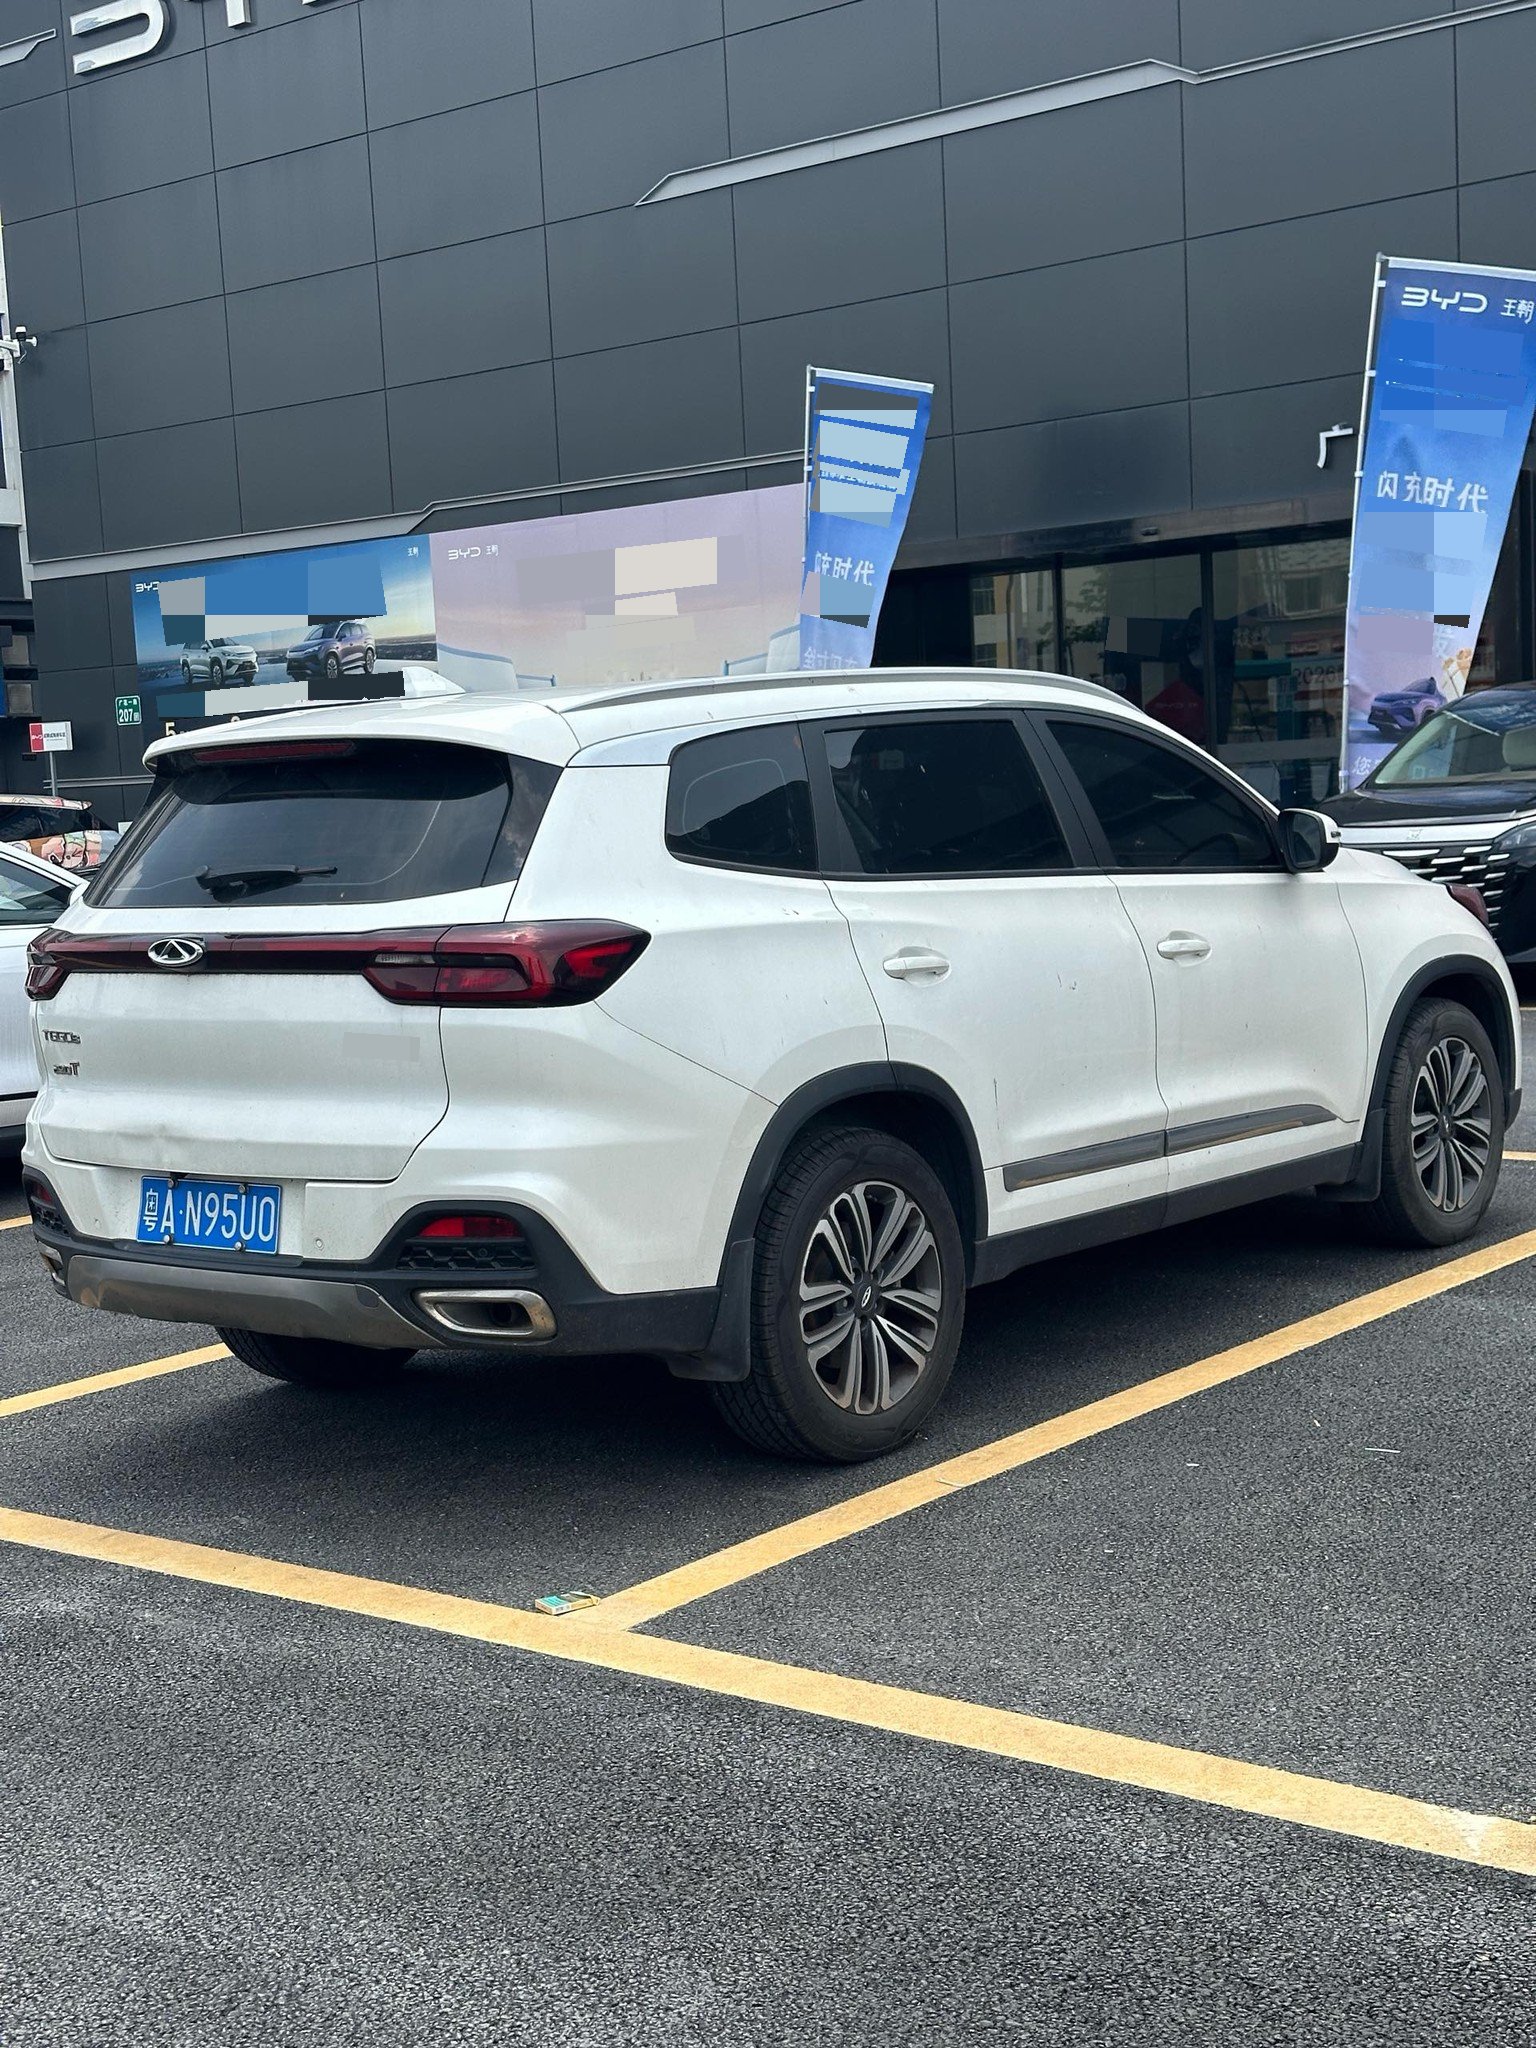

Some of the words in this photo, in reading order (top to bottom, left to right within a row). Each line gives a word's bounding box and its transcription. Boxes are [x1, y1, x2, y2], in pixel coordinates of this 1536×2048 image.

[1401, 286, 1488, 313] BYD
[1500, 298, 1535, 325] 王朝
[1377, 470, 1489, 514] 闪充时代
[447, 546, 481, 560] BYD
[118, 709, 133, 722] 207
[142, 1188, 276, 1242] 粤A·N95U0
